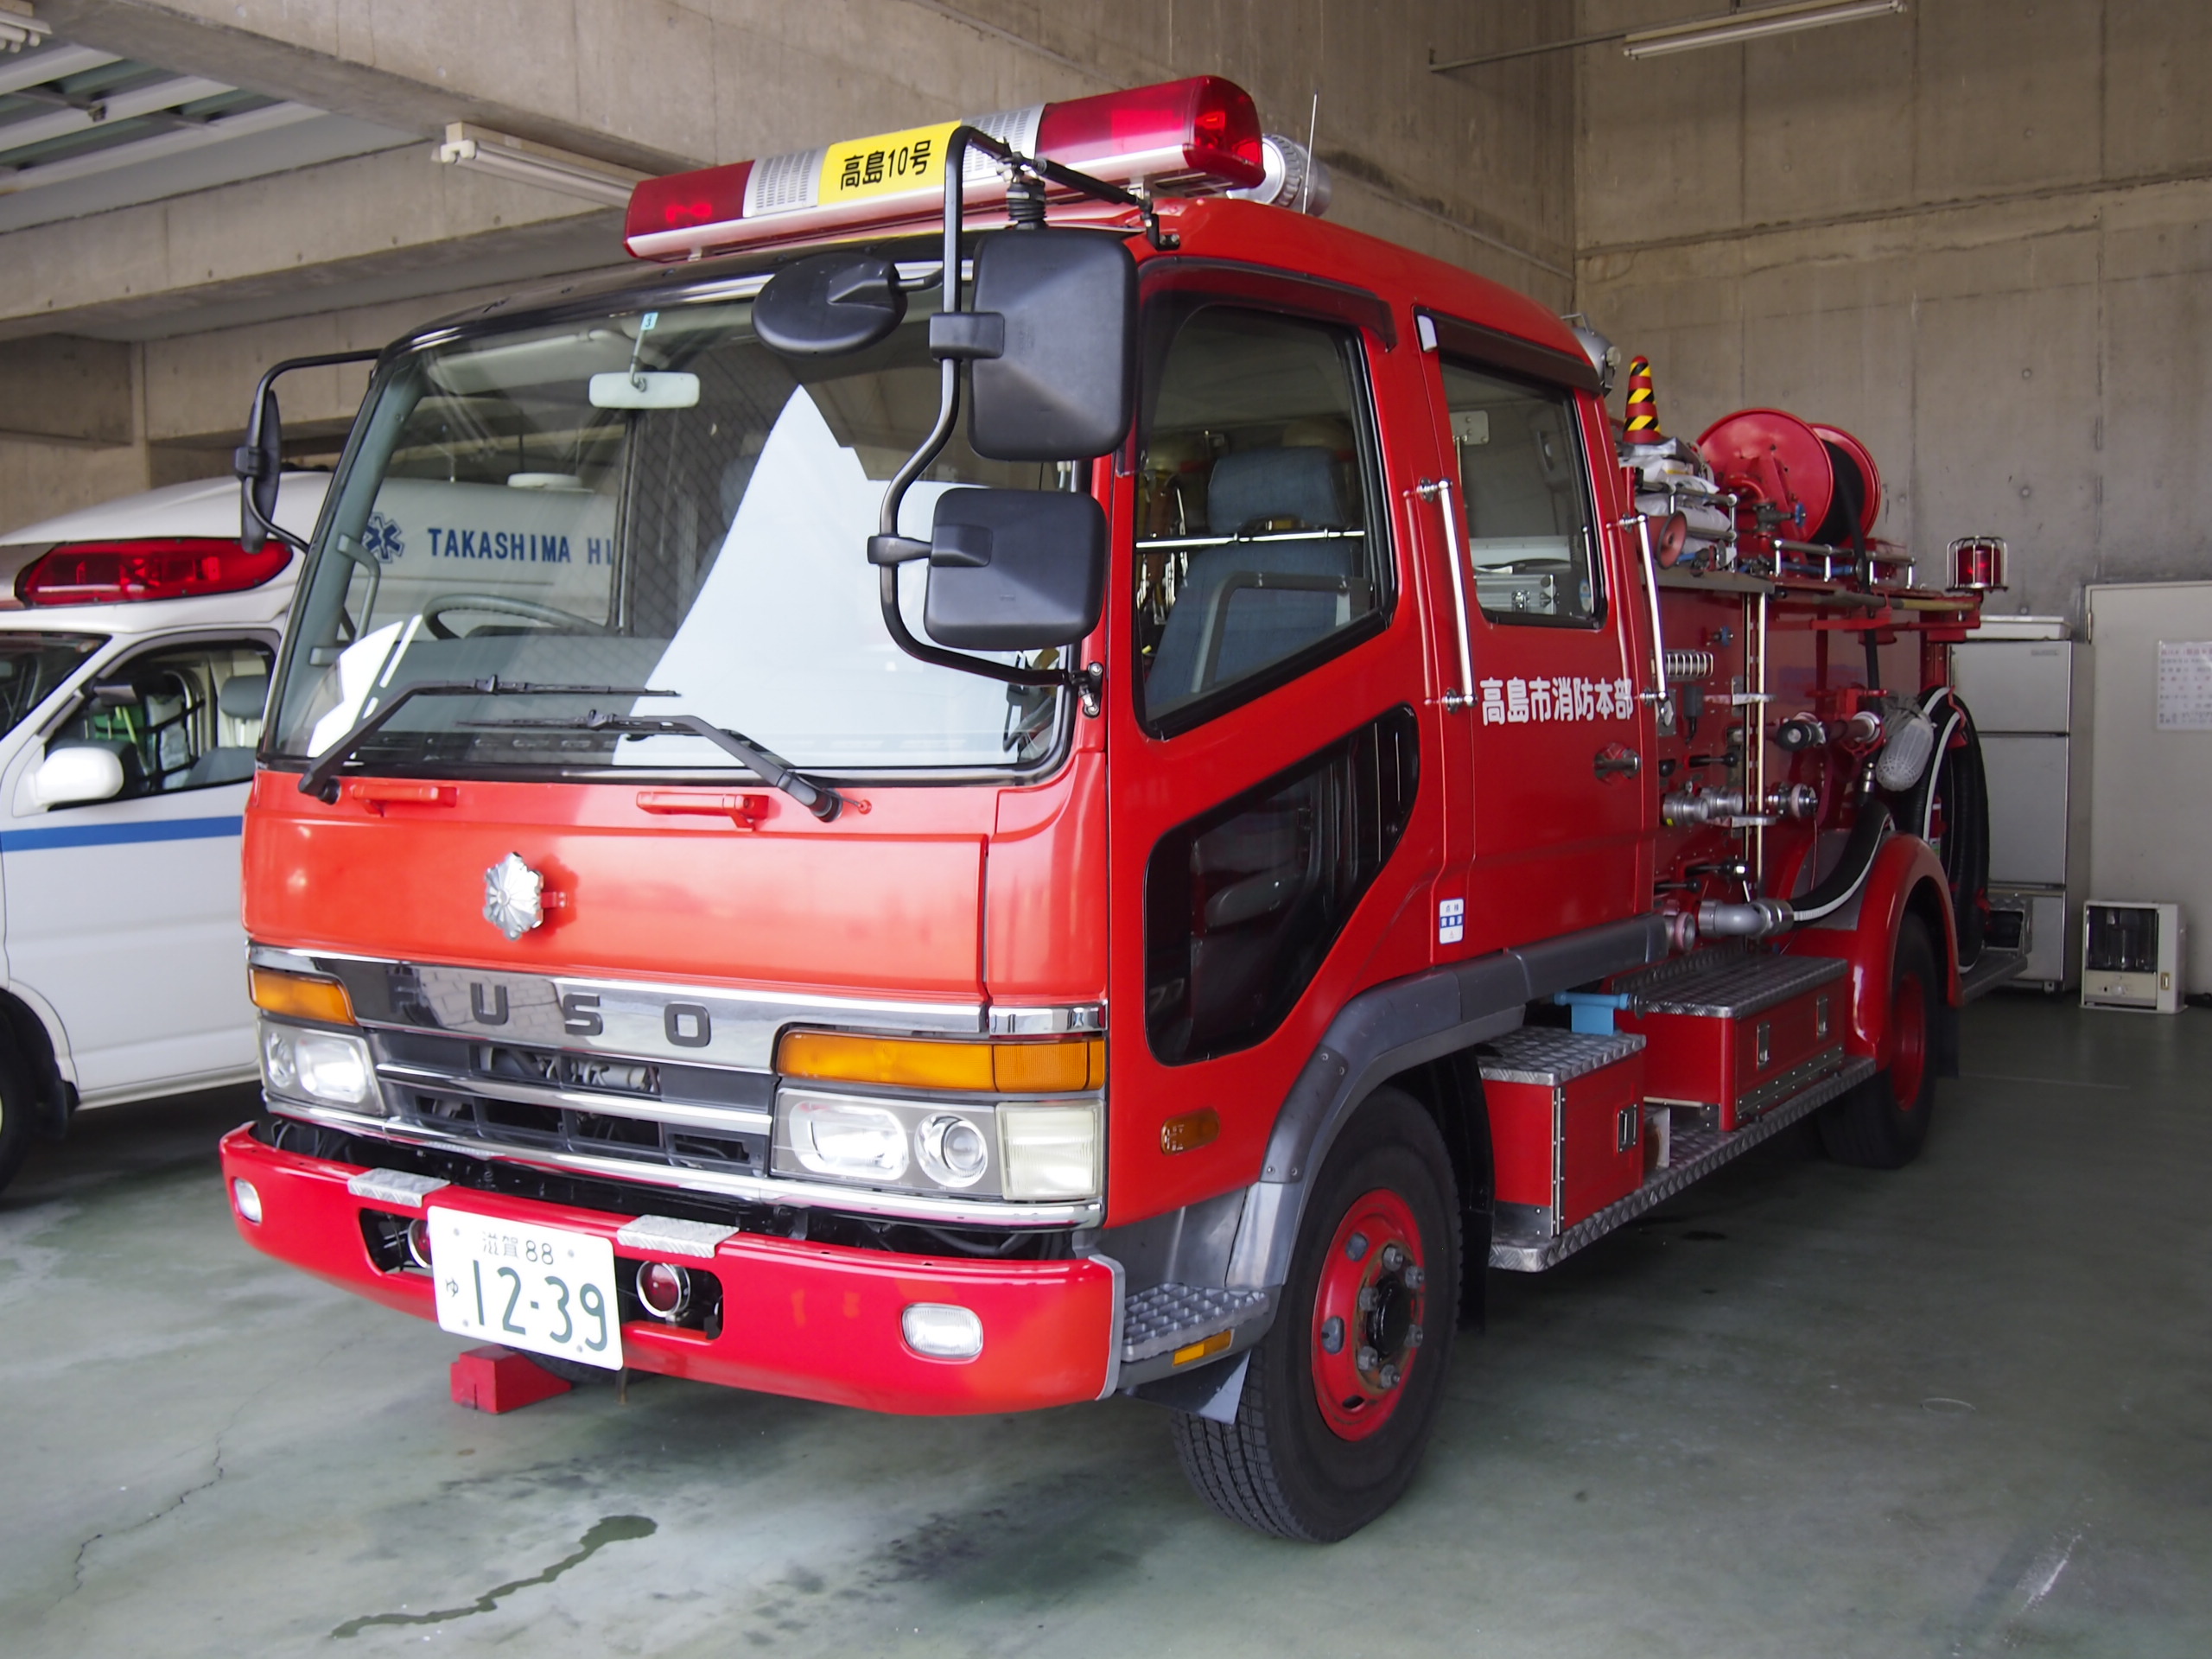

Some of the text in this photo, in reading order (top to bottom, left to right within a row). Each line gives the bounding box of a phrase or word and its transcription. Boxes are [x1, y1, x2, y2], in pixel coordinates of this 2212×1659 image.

[841, 140, 931, 191] 高島10号
[428, 528, 571, 563] TAKASHIMA
[1479, 676, 1634, 727] 高島市消防本部
[387, 974, 712, 1048] FUSO
[482, 1230, 554, 1266] 滋賀 88
[445, 1259, 608, 1352] ゆ 12-39
